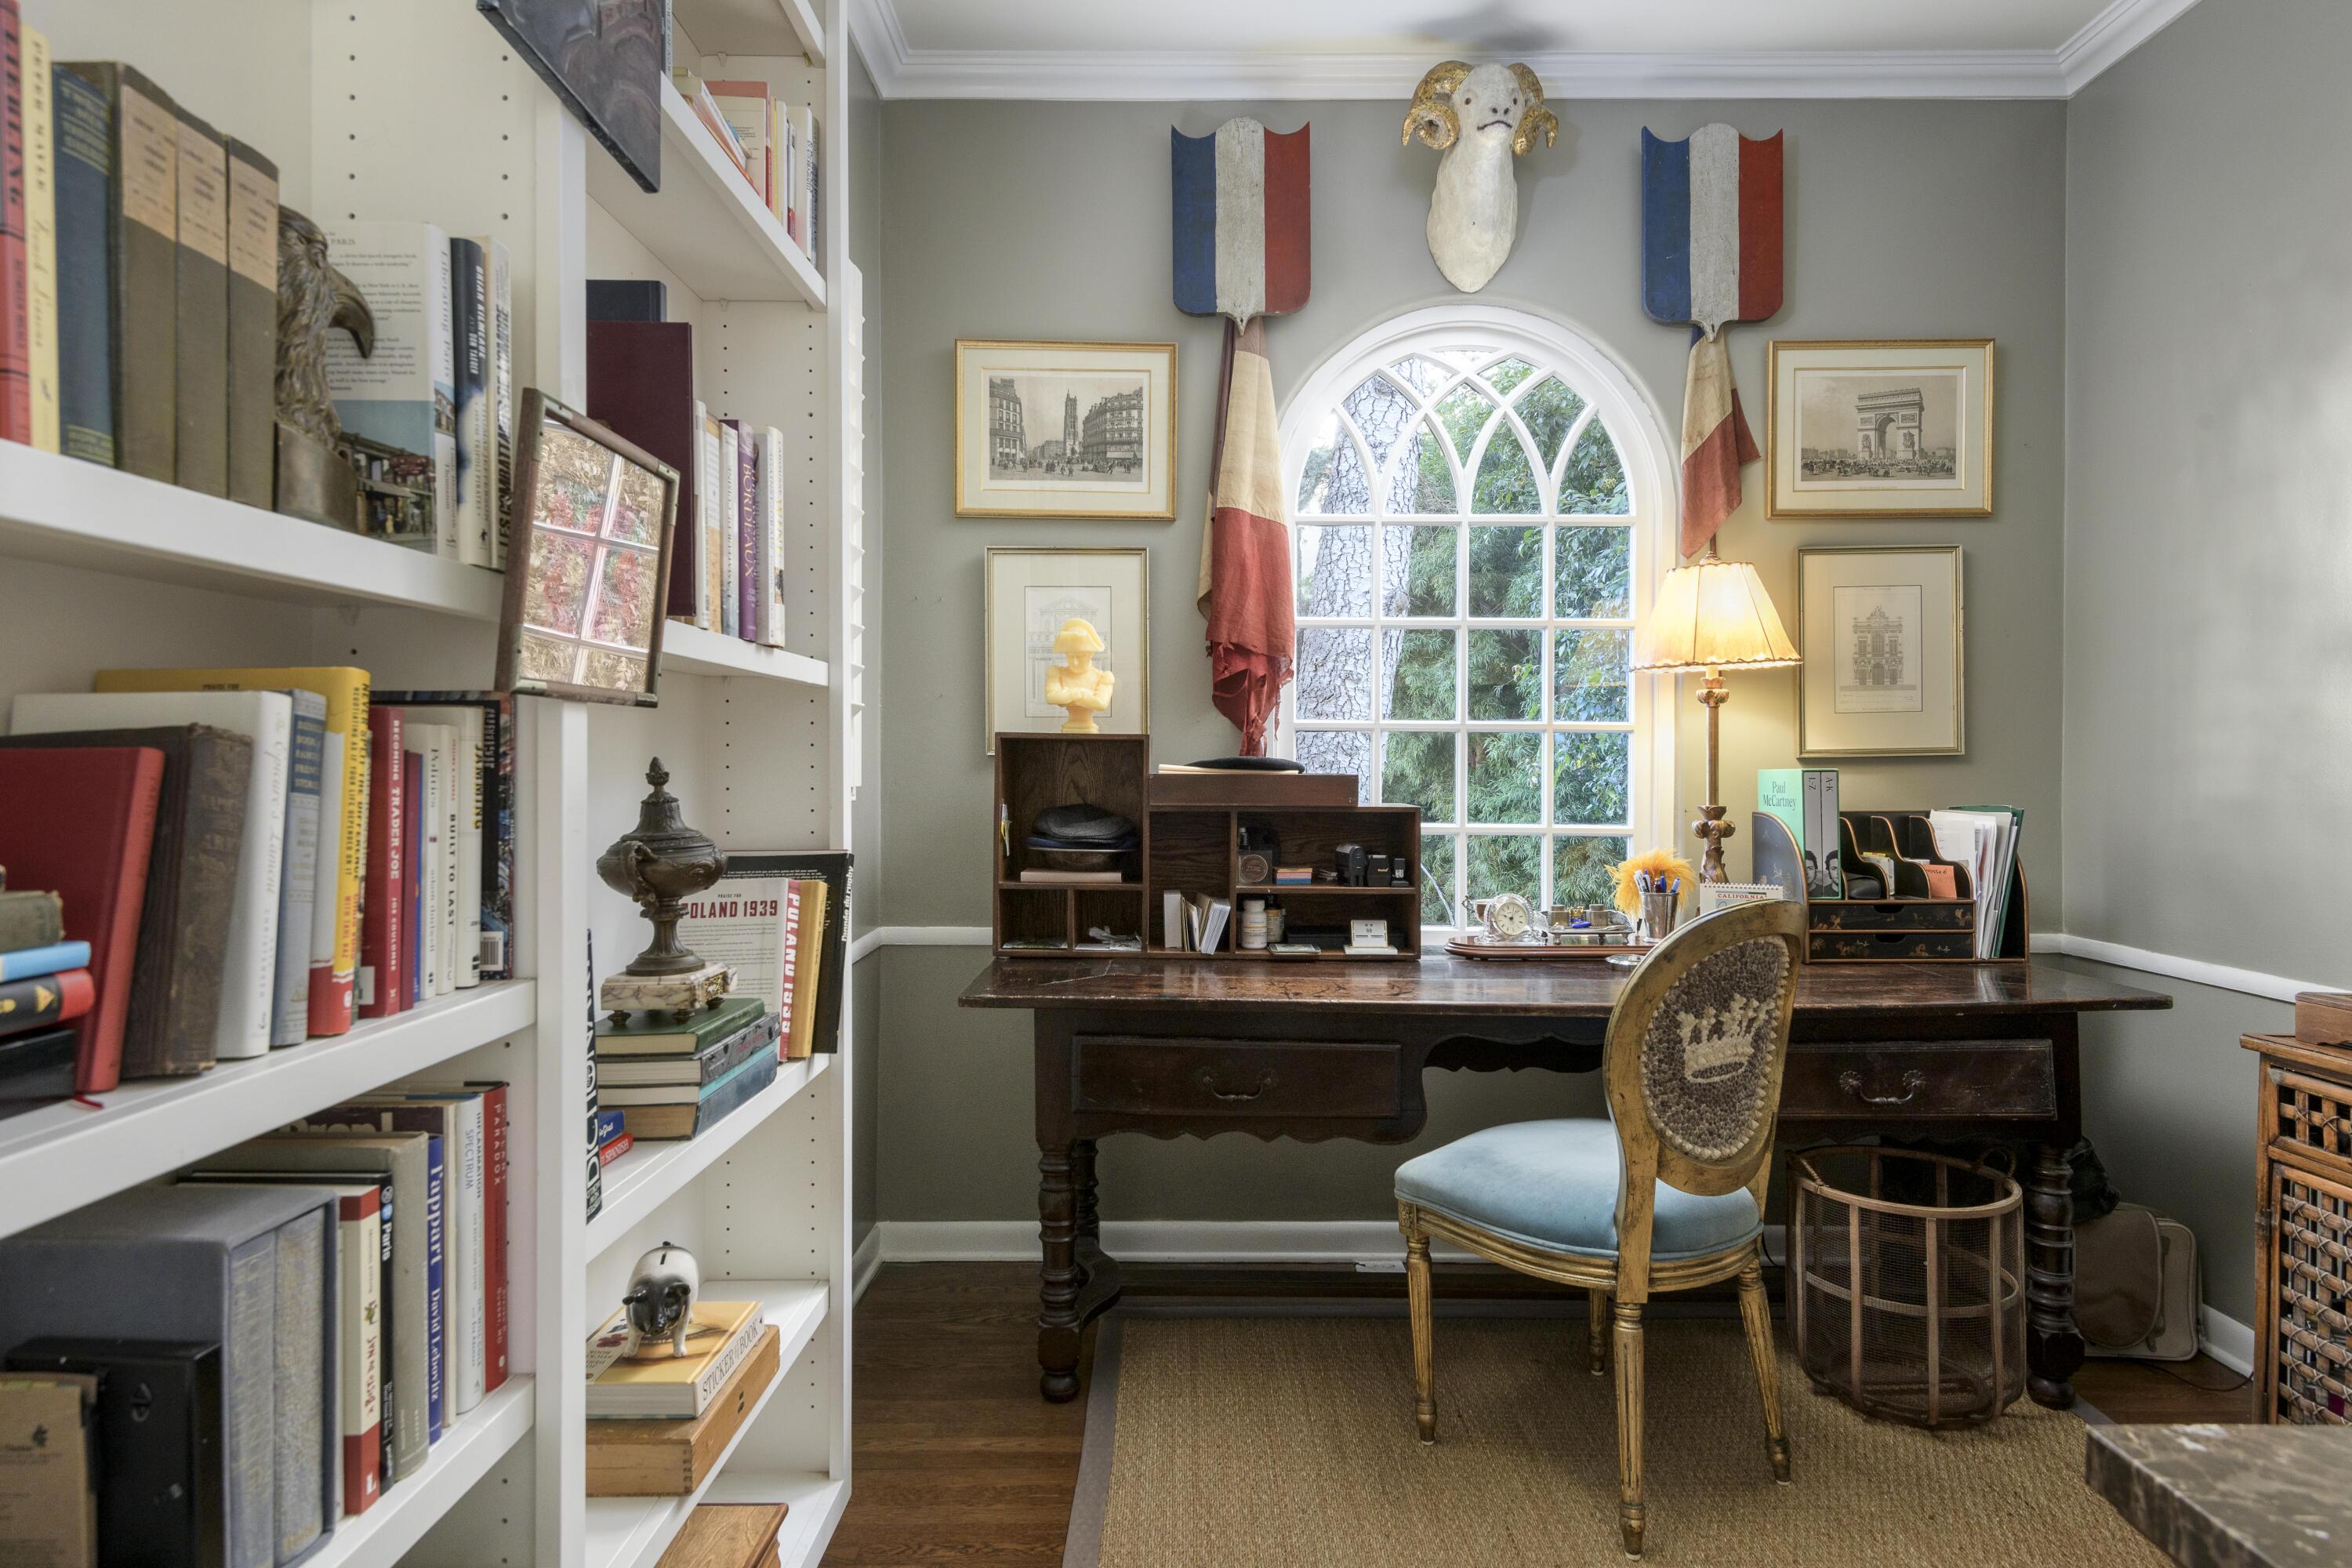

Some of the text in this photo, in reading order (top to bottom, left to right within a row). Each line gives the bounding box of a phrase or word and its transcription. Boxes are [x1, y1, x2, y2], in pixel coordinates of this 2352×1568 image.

[475, 265, 486, 358] BRIAN KILMEADE
[743, 463, 755, 578] BORDEAUX
[474, 744, 484, 830] JAMMING
[1762, 793, 1797, 811] McCartney
[1771, 781, 1786, 794] Paul
[1808, 777, 1817, 790] L-Z
[1825, 777, 1834, 792] A-K
[390, 786, 401, 847] TRADER
[390, 849, 400, 880] JOE
[448, 864, 456, 882] TO
[742, 899, 778, 917] 1939
[781, 892, 800, 1033] POLAND 1939
[465, 1129, 474, 1189] SPECTRUM
[493, 1104, 502, 1185] PARADOX
[382, 1221, 392, 1261] Paris
[431, 1288, 441, 1334] David
[430, 1335, 441, 1402] Lebovitz
[702, 1321, 759, 1401] STICKER BOOK
